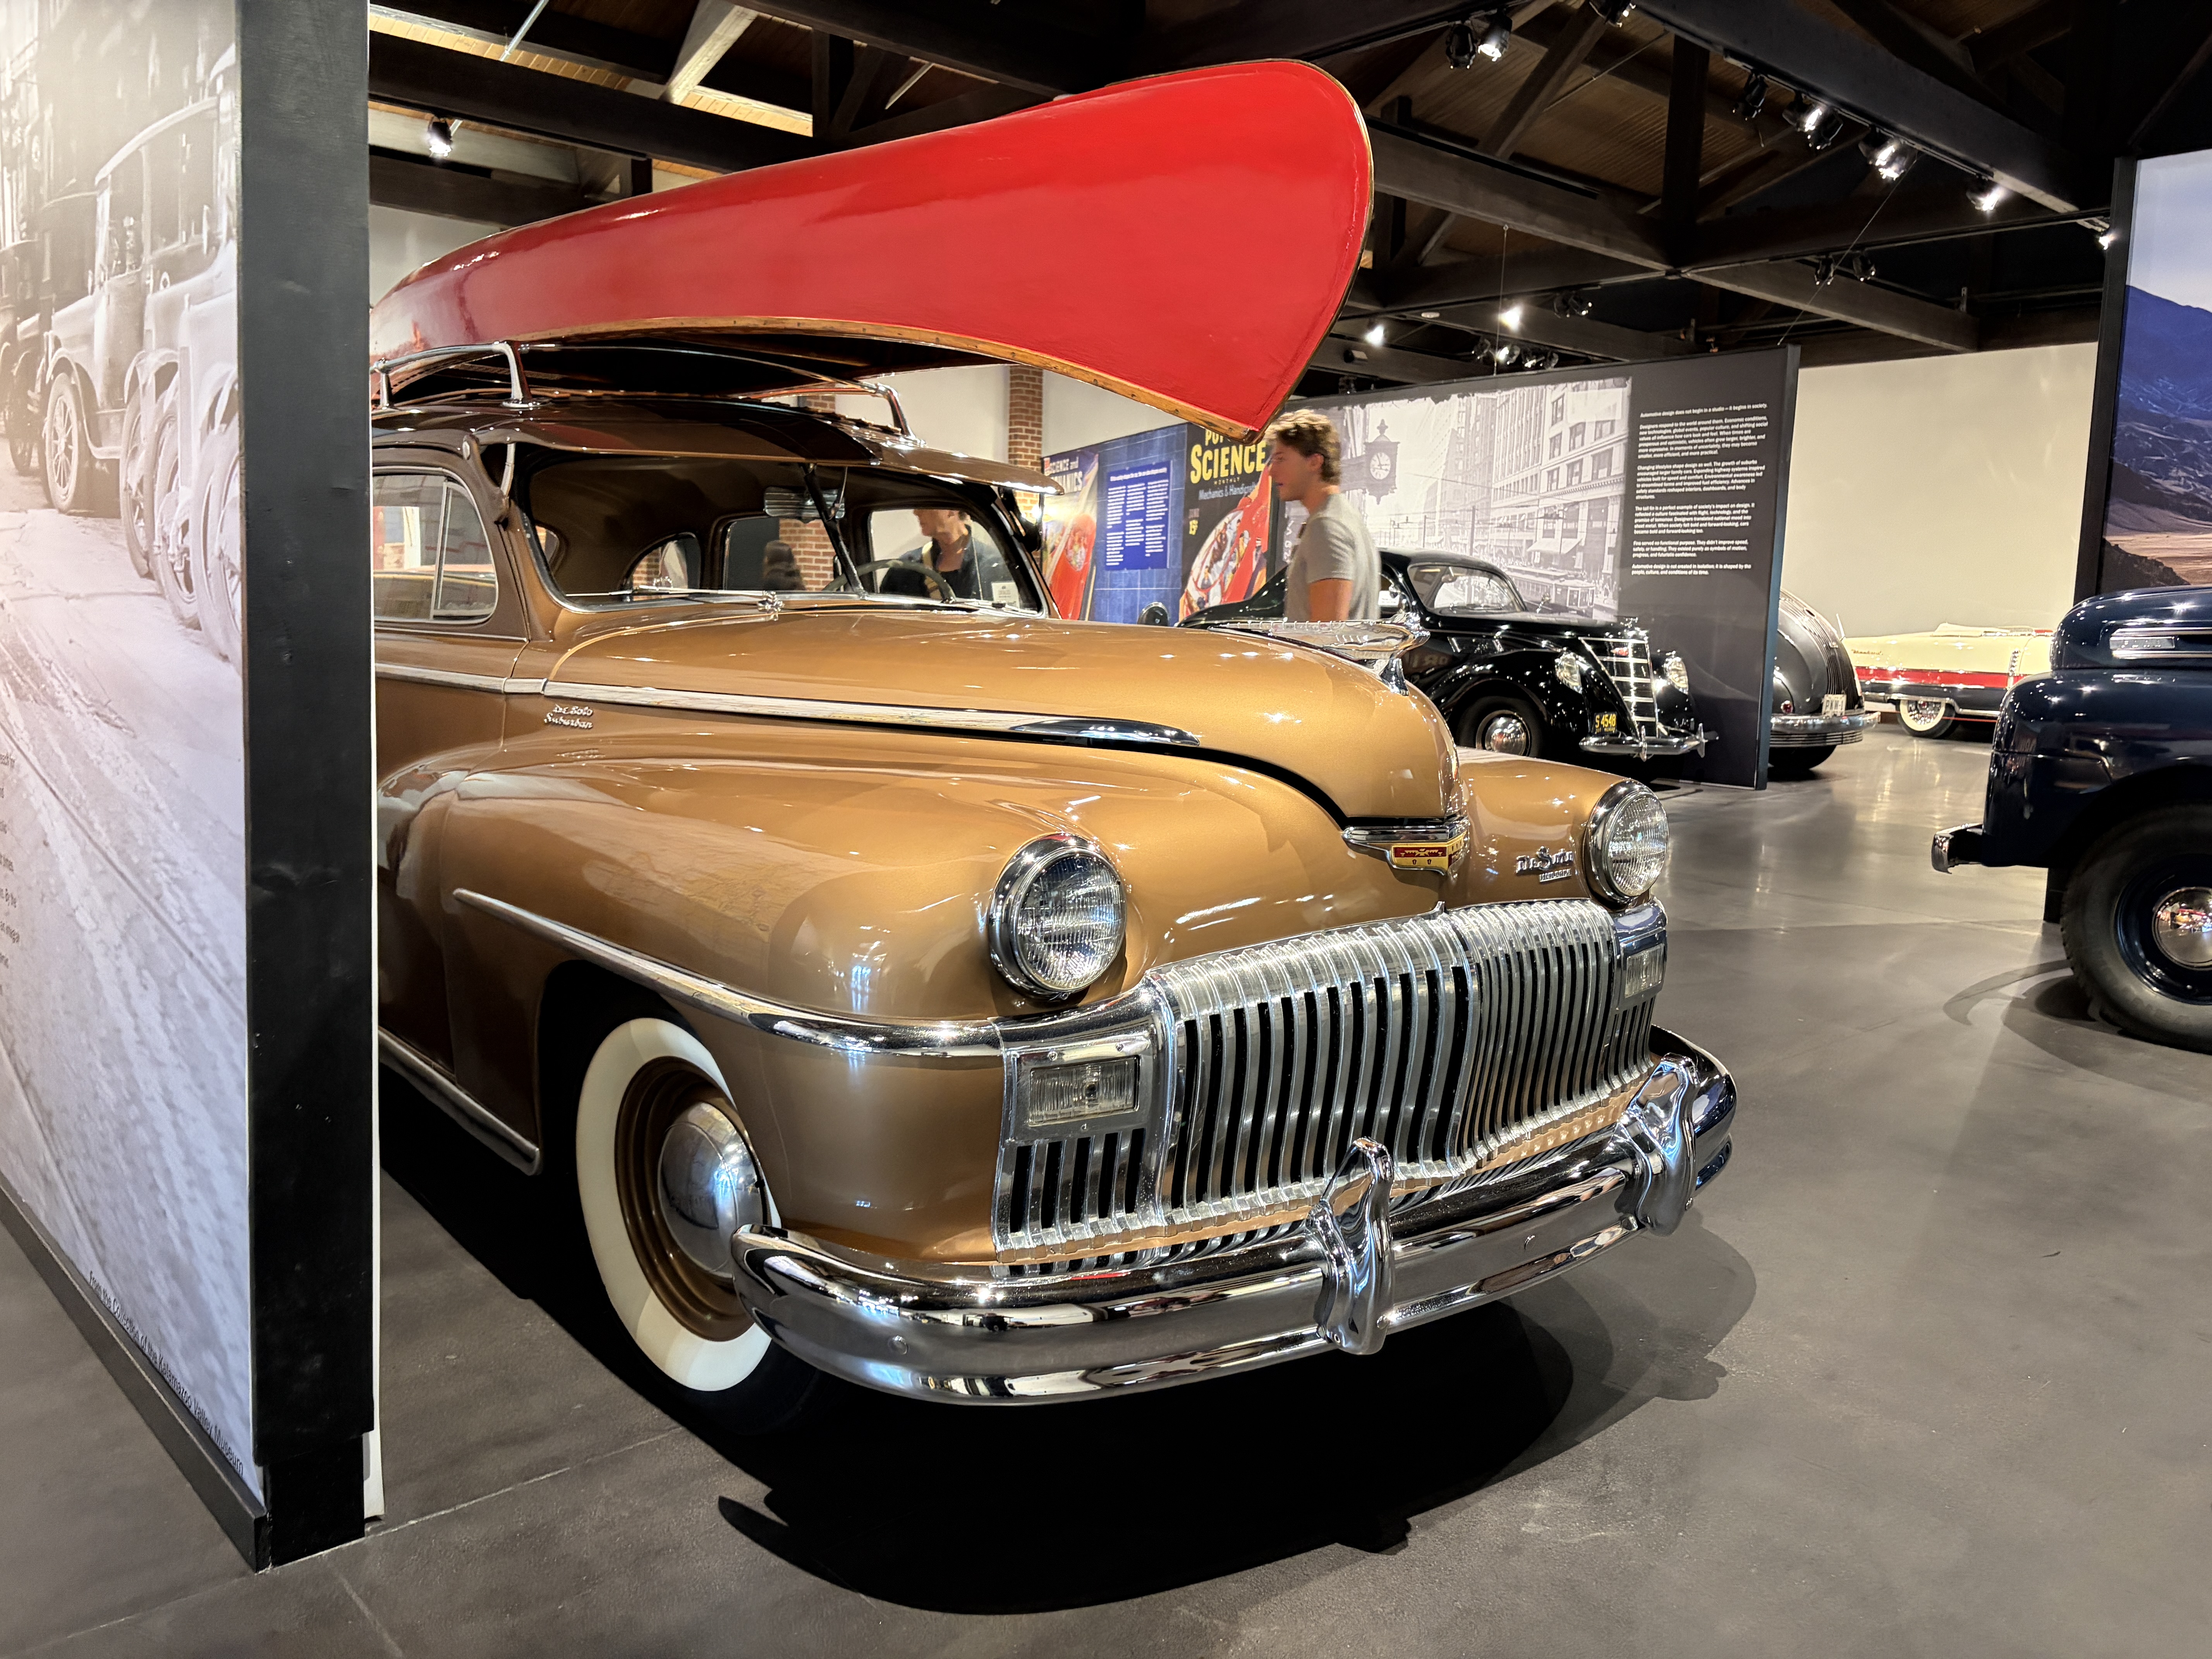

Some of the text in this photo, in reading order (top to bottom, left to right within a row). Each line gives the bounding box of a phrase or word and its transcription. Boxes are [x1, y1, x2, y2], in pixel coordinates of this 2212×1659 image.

[1190, 440, 1267, 484] SCIENCE
[1213, 477, 1240, 486] MONTHLY
[544, 712, 593, 728] Suburban
[1595, 714, 1616, 728] S 4548
[140, 1335, 147, 1351] of
[159, 1353, 192, 1408] Kalamazoo
[194, 1397, 213, 1437] Valley
[215, 1424, 244, 1477] Museum
